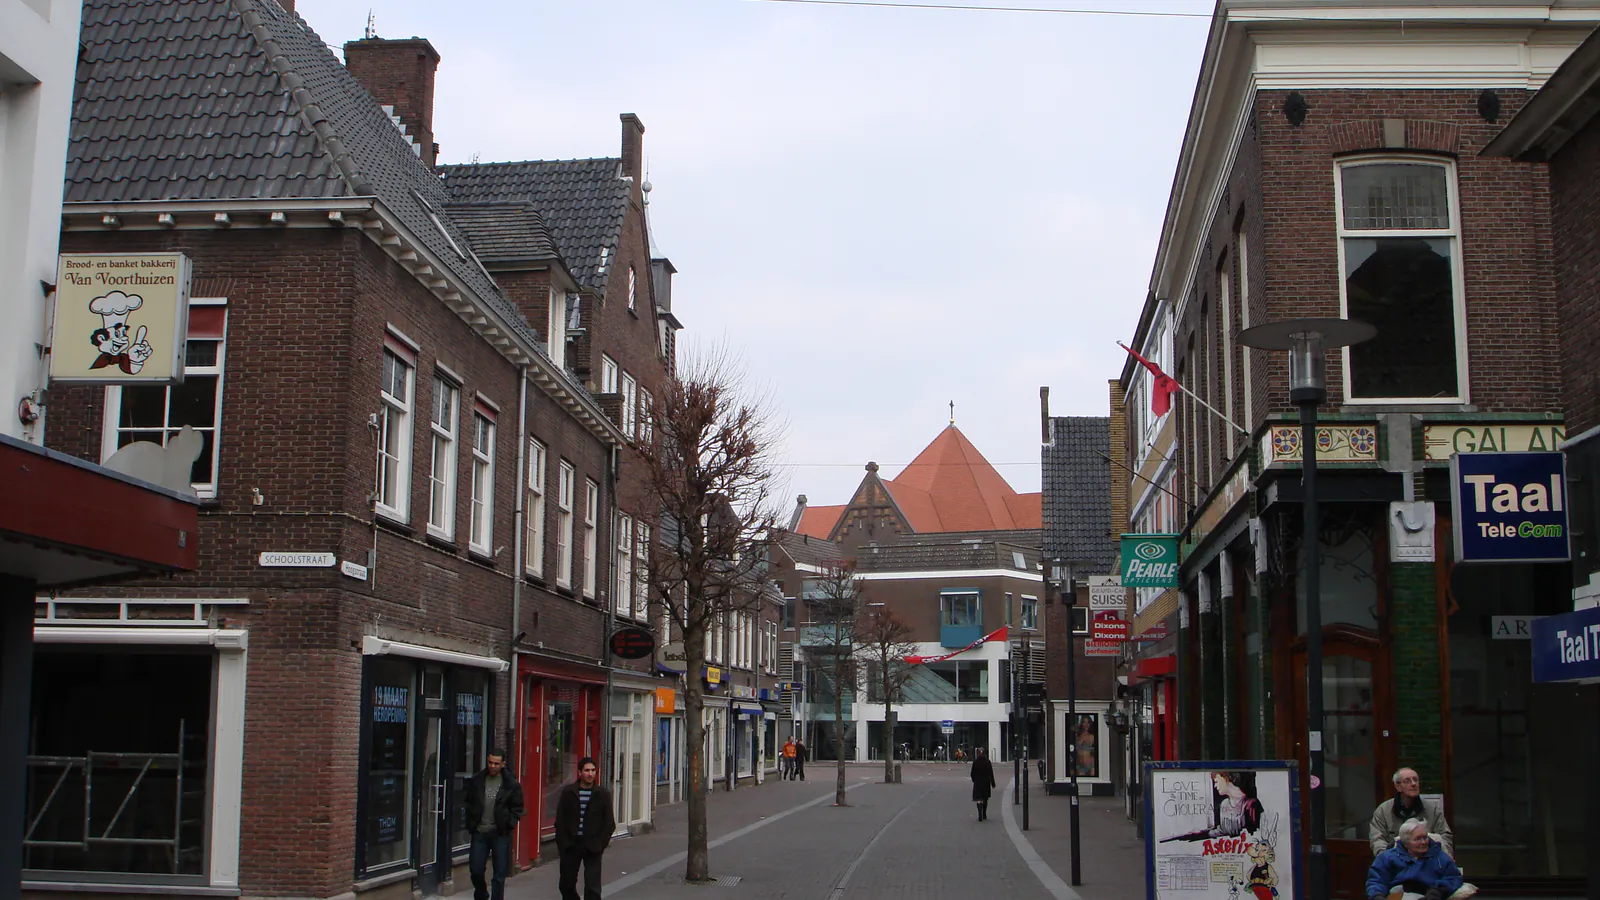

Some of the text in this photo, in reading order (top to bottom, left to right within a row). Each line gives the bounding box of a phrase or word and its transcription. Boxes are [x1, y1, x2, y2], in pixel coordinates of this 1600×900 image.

[65, 259, 176, 270] Brood- en banket bakkerij
[64, 272, 175, 286] Van Voorthuizen
[1463, 473, 1563, 513] Taal
[1477, 521, 1562, 538] TeleCom
[265, 555, 327, 564] SCHOOLSTRAAT
[1126, 559, 1177, 578] PEARLE
[384, 687, 408, 706] MAART
